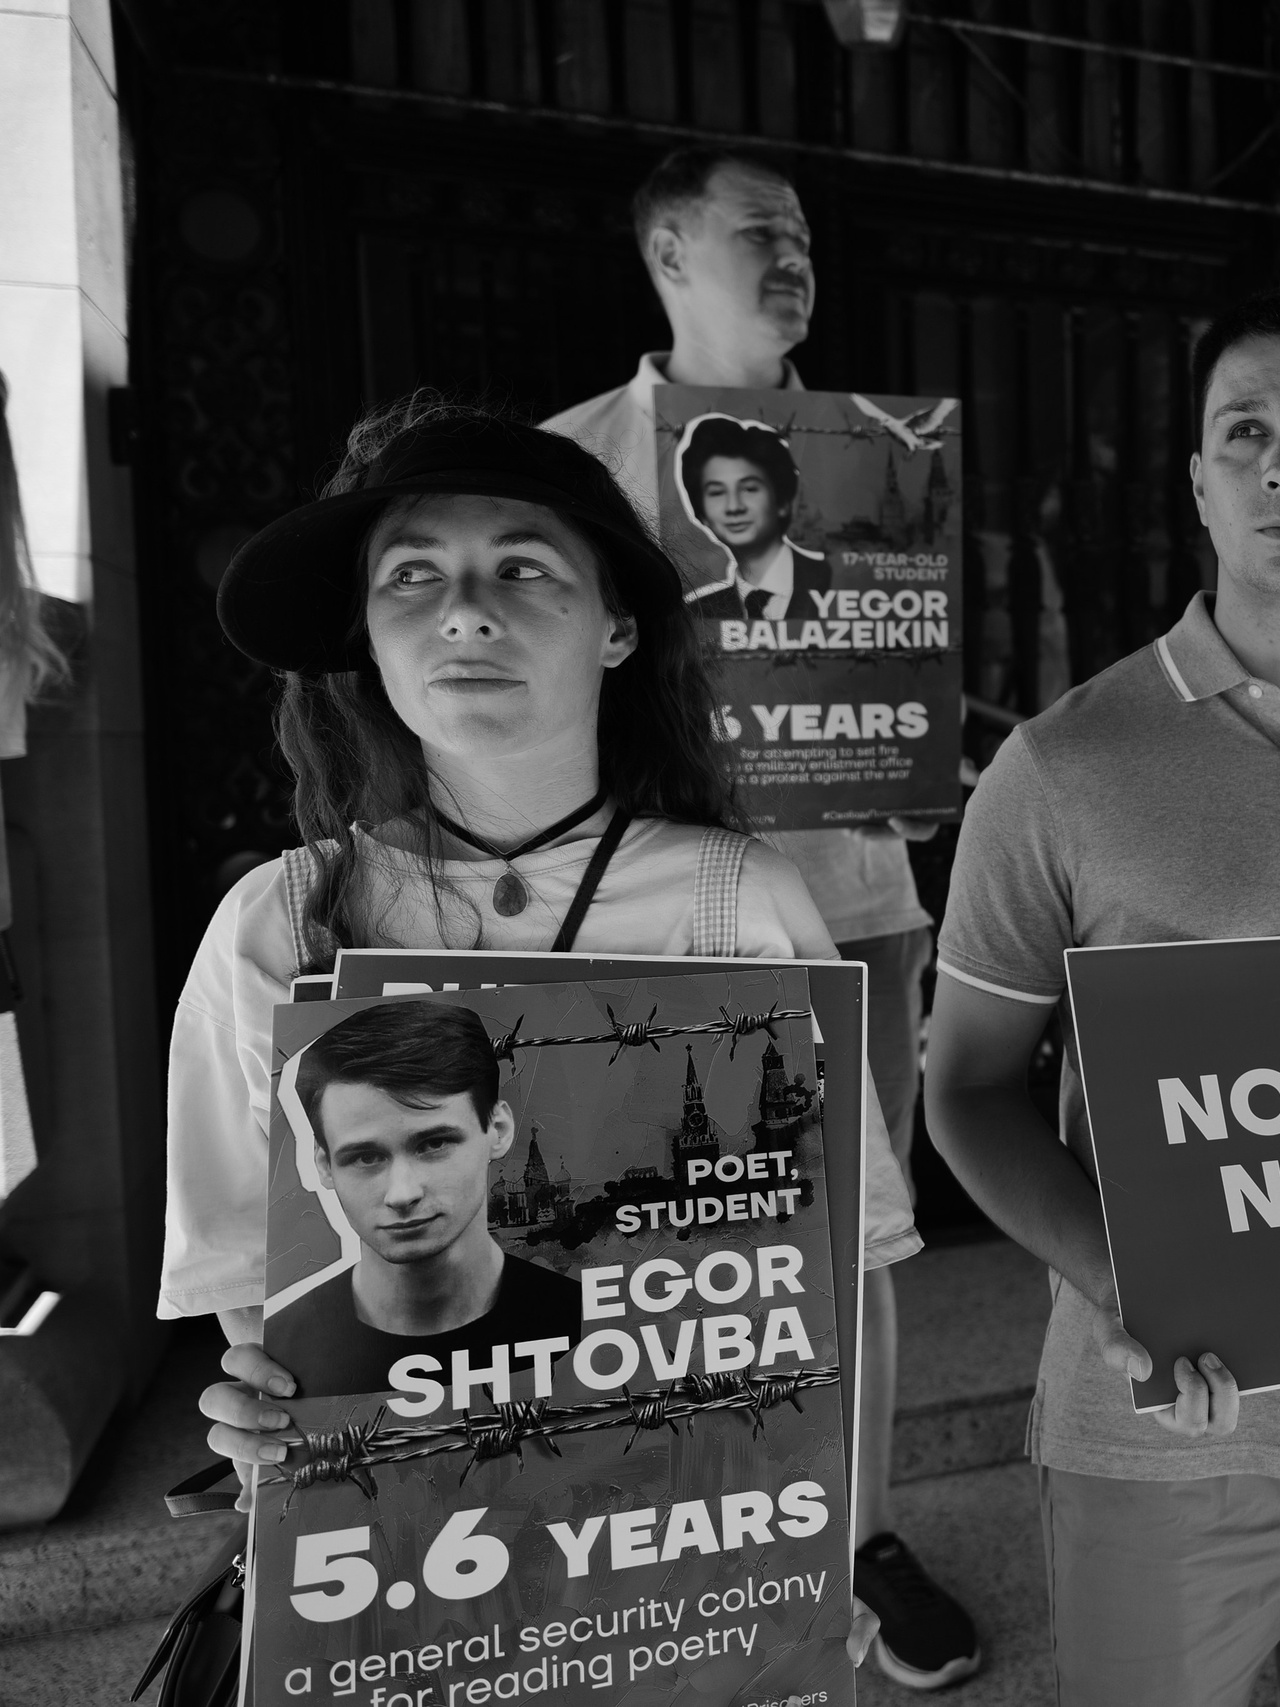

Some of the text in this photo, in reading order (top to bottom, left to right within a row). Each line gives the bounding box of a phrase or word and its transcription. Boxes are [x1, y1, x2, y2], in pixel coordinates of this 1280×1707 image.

[842, 552, 948, 567] 17-YEAR-OLD
[874, 567, 948, 581] STUDENT
[808, 589, 948, 619] YEGOR
[720, 620, 949, 650] BALAZEIKIN
[751, 702, 929, 741] YEARS
[757, 760, 806, 773] military
[808, 757, 877, 770] enlistment
[879, 756, 913, 768] office
[839, 747, 854, 758] to
[856, 746, 876, 757] set
[878, 744, 899, 756] fire
[762, 772, 809, 786] protest
[812, 770, 861, 785] against
[863, 769, 885, 781] the
[887, 769, 911, 780] war
[687, 1150, 799, 1188] POET,
[615, 1188, 802, 1233] STUDENT
[582, 1244, 806, 1321] EGOR
[386, 1305, 815, 1419] SHTOVBA
[288, 1480, 829, 1624] 5.6 YEARS
[284, 1570, 827, 1697] a general security colony
[370, 1622, 758, 1707] for reading poetry
